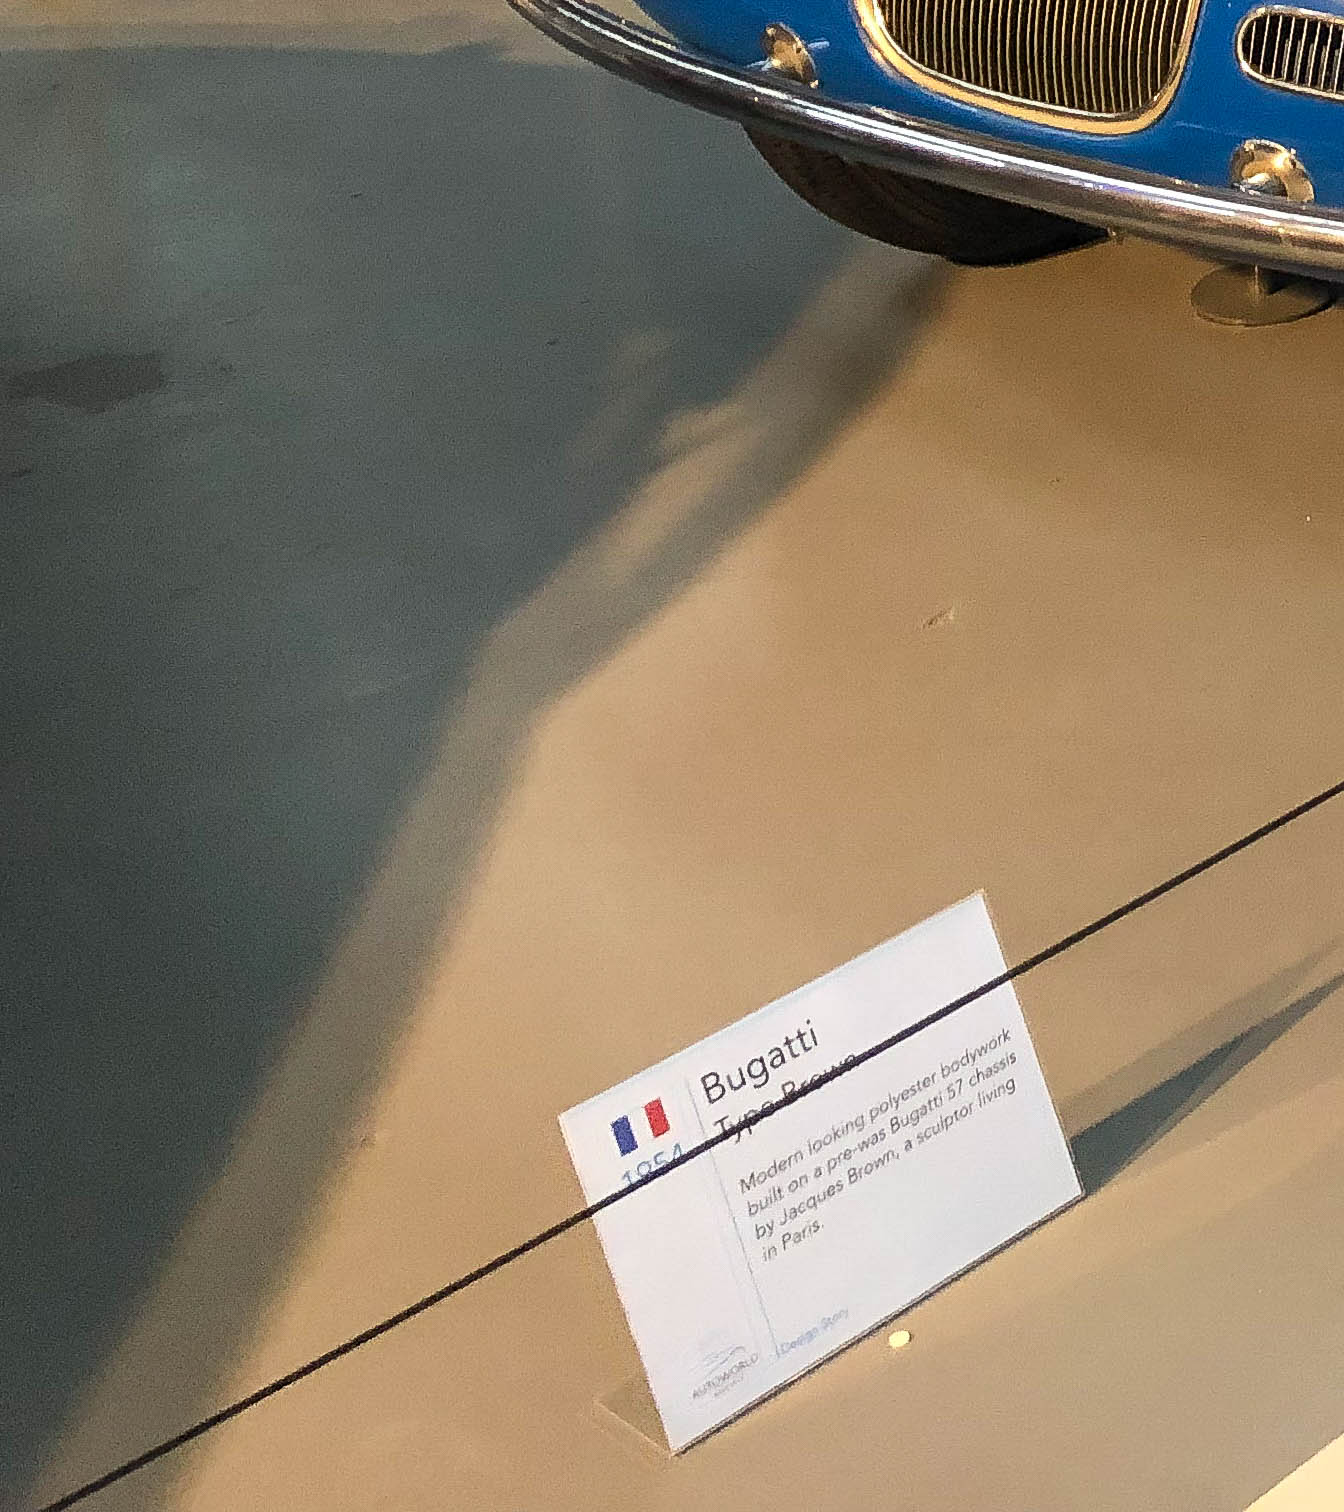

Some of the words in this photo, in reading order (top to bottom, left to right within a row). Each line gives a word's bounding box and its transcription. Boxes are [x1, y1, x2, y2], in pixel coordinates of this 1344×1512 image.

[700, 1018, 819, 1105] Bugatti
[739, 1149, 804, 1195] Modern
[806, 1114, 866, 1155] looking
[868, 1072, 937, 1125] polyester
[939, 1028, 1011, 1080] bodywork
[748, 1187, 785, 1217] built
[787, 1173, 809, 1194] on
[813, 1165, 823, 1179] a
[826, 1129, 887, 1175] pre-was
[890, 1094, 944, 1136] Bugatti
[946, 1078, 964, 1101] 57
[967, 1050, 1018, 1088] chassis
[754, 1218, 775, 1241] by
[779, 1180, 845, 1226] Jacques
[847, 1147, 900, 1186] Brown,
[903, 1139, 913, 1153] a
[917, 1102, 975, 1140] sculptor
[978, 1077, 1017, 1108] living
[761, 1244, 778, 1263] in
[781, 1221, 825, 1252] Paris.
